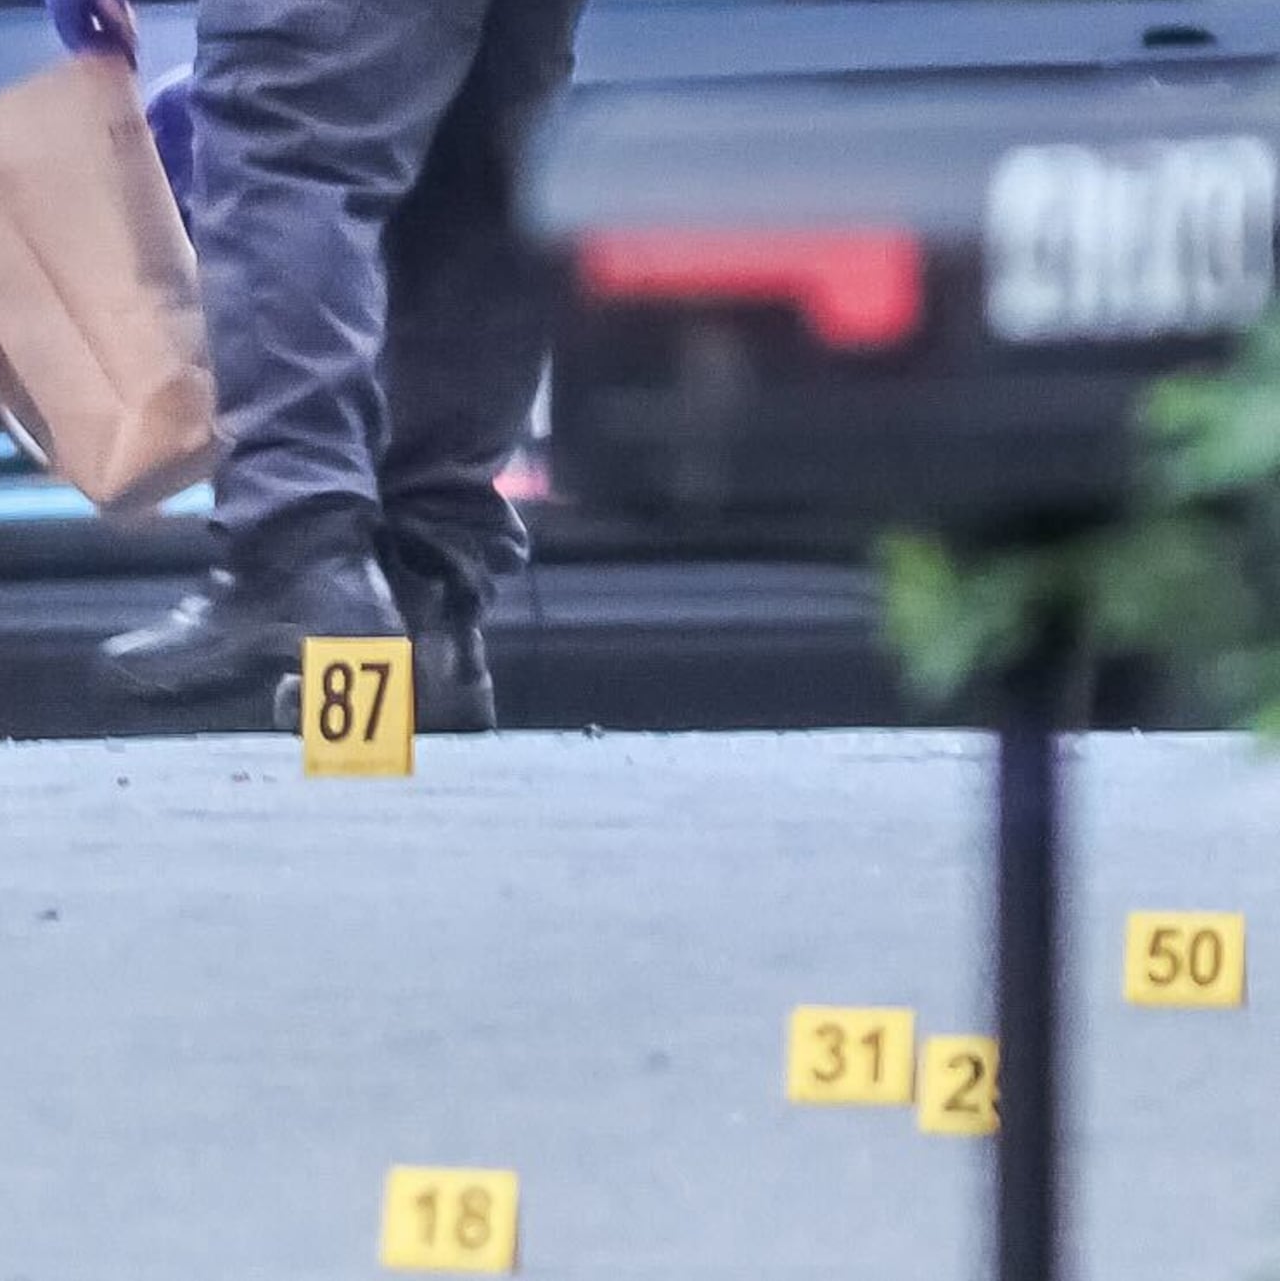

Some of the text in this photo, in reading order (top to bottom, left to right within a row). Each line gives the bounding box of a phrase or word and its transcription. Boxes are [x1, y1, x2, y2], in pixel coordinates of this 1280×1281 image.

[319, 662, 390, 742] 87
[1147, 928, 1223, 986] 50
[811, 1024, 887, 1084] 31
[942, 1053, 1001, 1114] 2
[414, 1185, 493, 1250] 18
